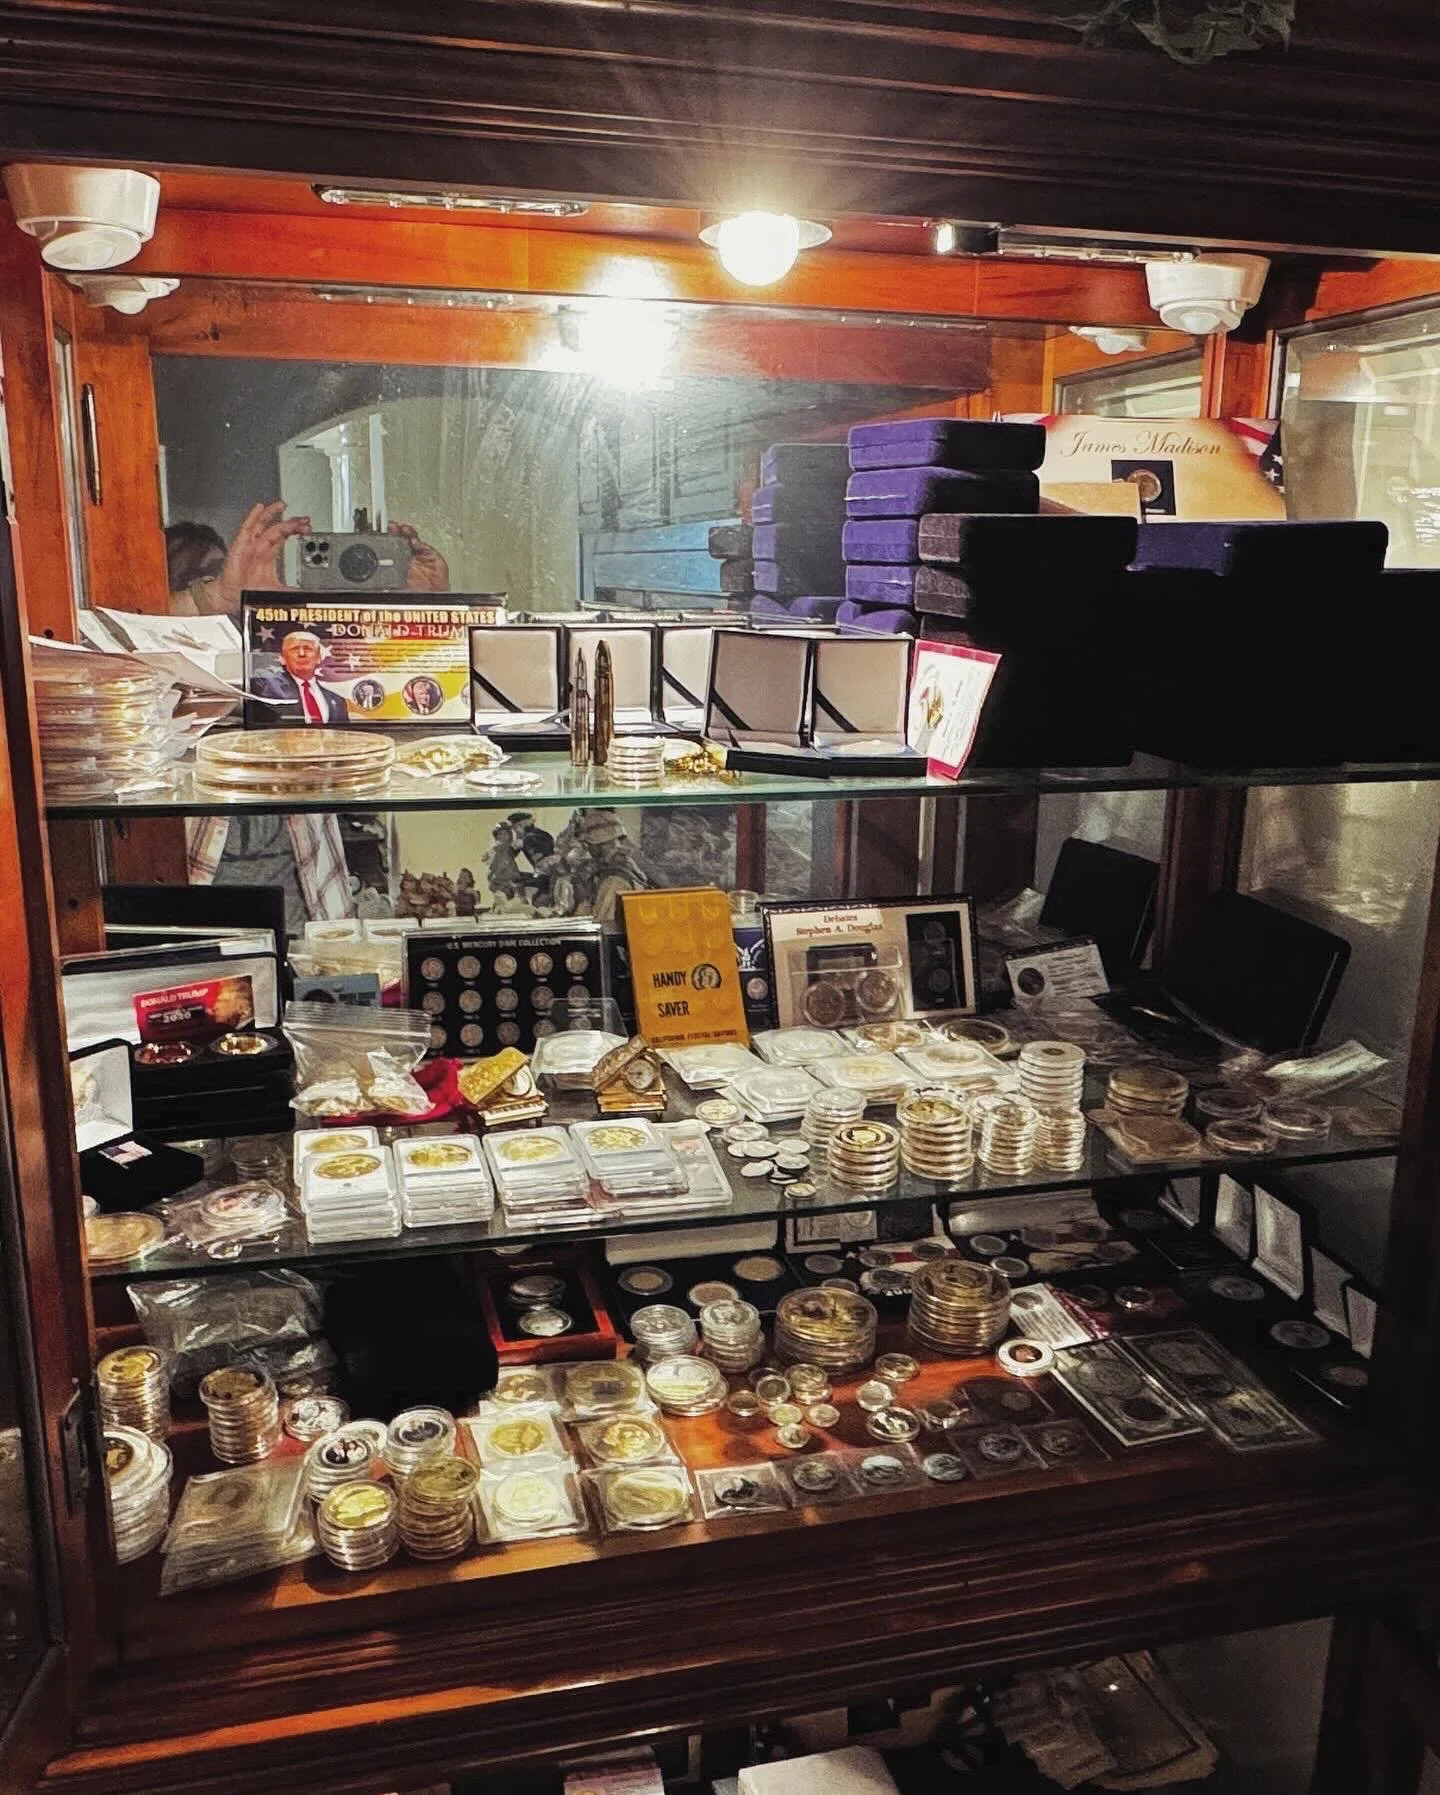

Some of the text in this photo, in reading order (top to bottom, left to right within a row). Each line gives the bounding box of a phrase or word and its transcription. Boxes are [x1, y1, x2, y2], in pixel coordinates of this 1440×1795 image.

[1060, 430, 1221, 457] James Madison
[256, 608, 496, 624] 45th PRESIDENT of the UNITED STATES
[332, 623, 466, 640] DONALD TRUM
[652, 971, 687, 988] HANDY
[140, 988, 208, 1008] DONALD TRUMP
[657, 1001, 690, 1018] SAVER
